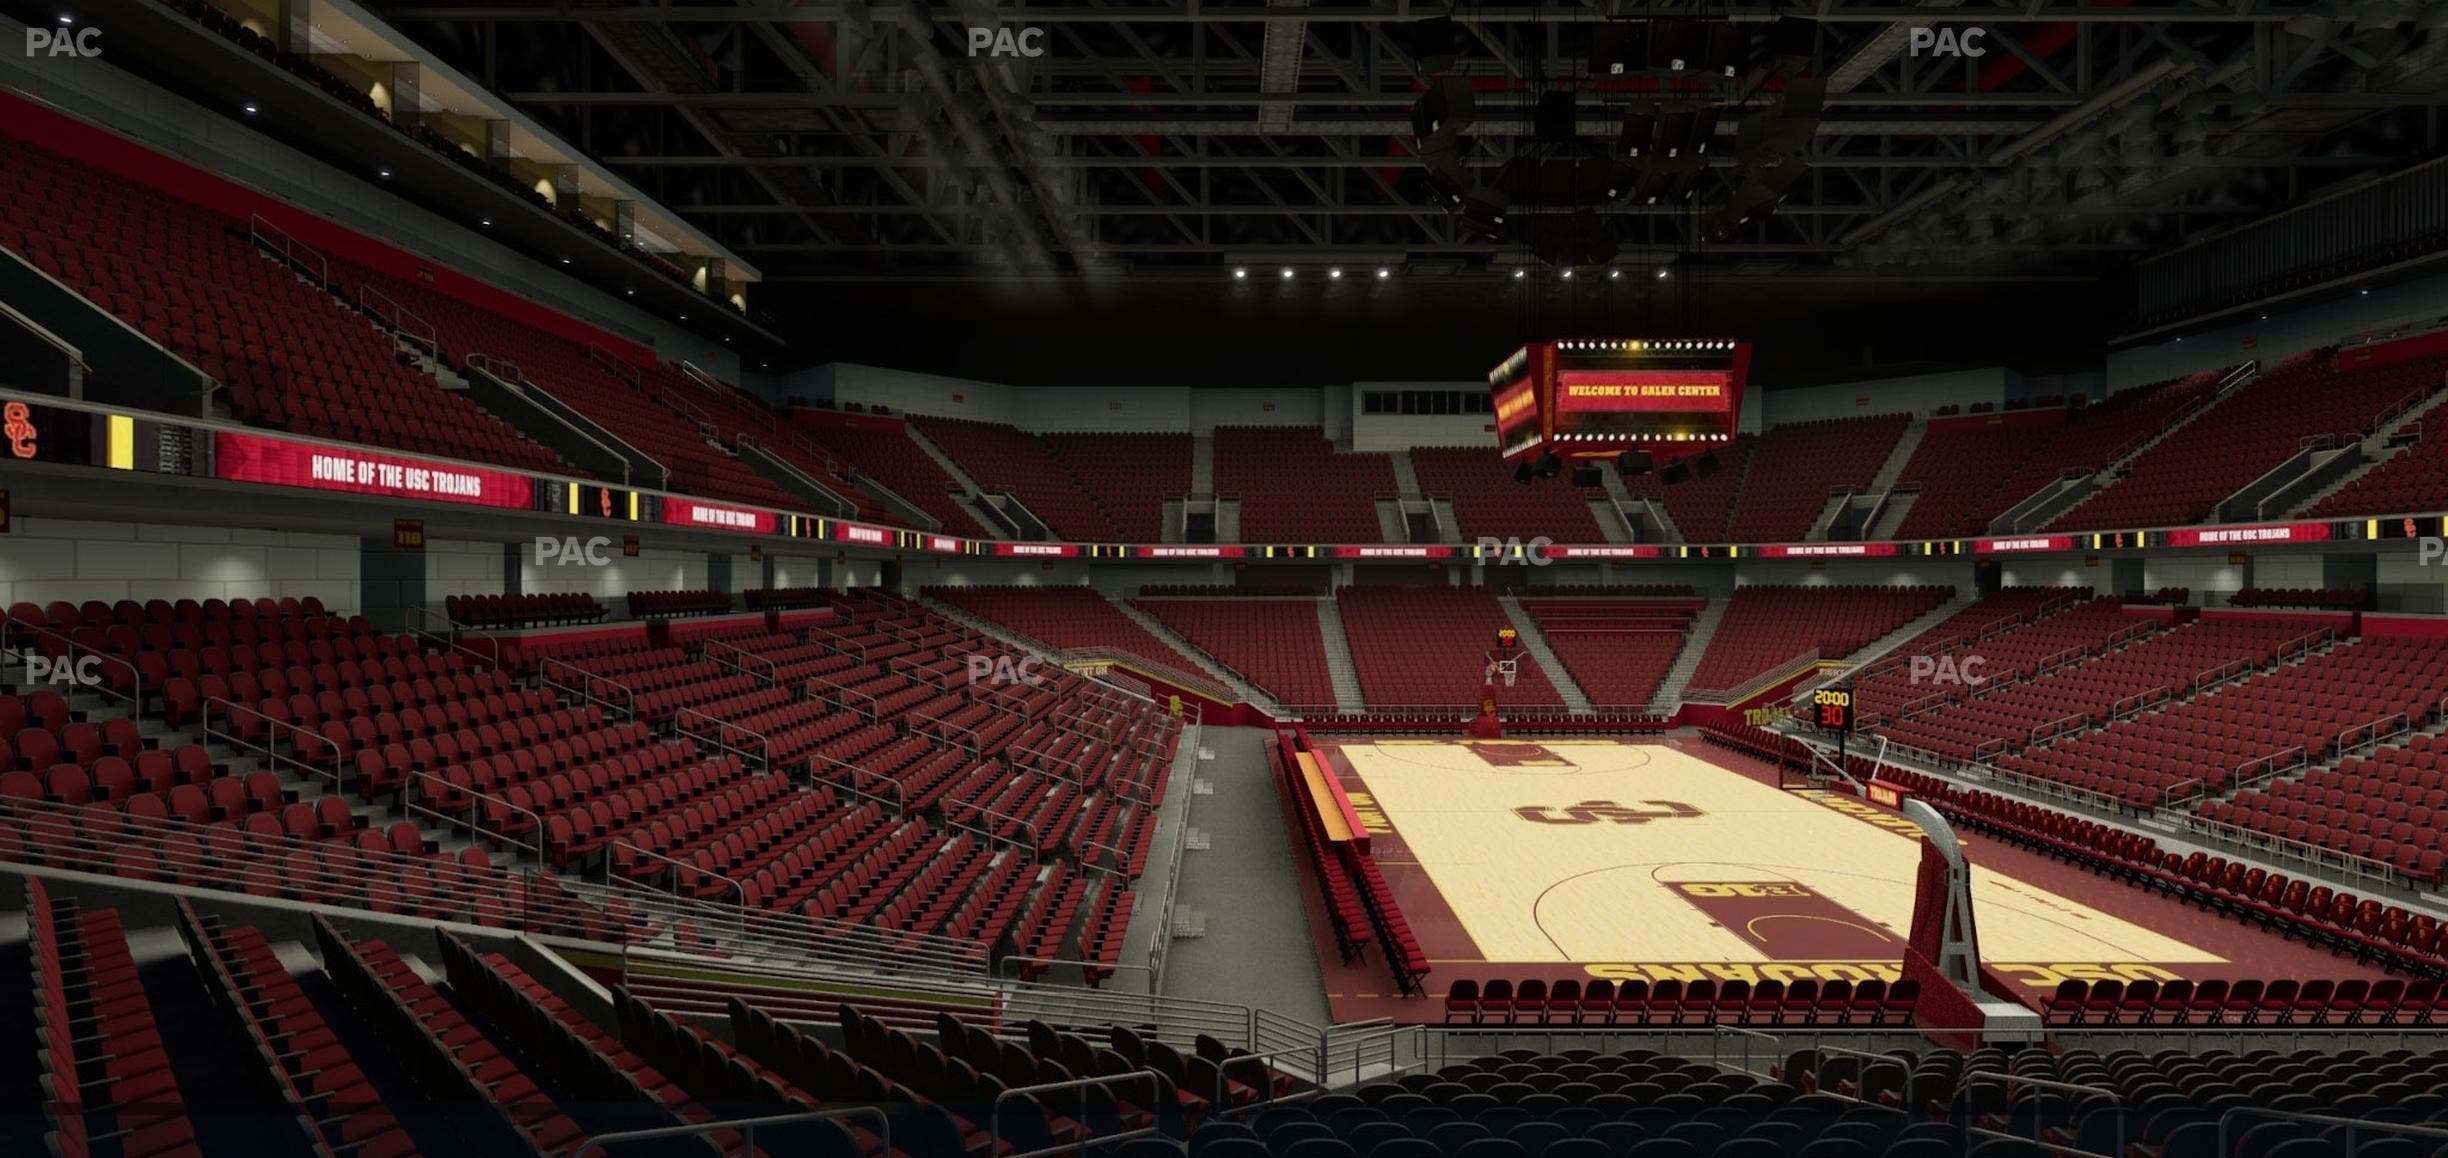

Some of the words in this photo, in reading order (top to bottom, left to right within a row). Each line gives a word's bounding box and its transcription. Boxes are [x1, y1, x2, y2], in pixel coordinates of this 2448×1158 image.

[1568, 385, 1621, 396] WELCOME
[1623, 385, 1638, 396] TO
[1640, 385, 1676, 396] GALEN
[1678, 385, 1721, 396] CENTER
[312, 454, 355, 483] HOME
[358, 461, 376, 485] OF
[378, 463, 403, 488] THE
[405, 467, 430, 491] USC
[432, 470, 481, 497] TROJANS
[2229, 530, 2242, 541] THE
[2258, 528, 2290, 540] TROJANS
[1814, 689, 1850, 707] 20:00
[1820, 705, 1844, 726] 30
